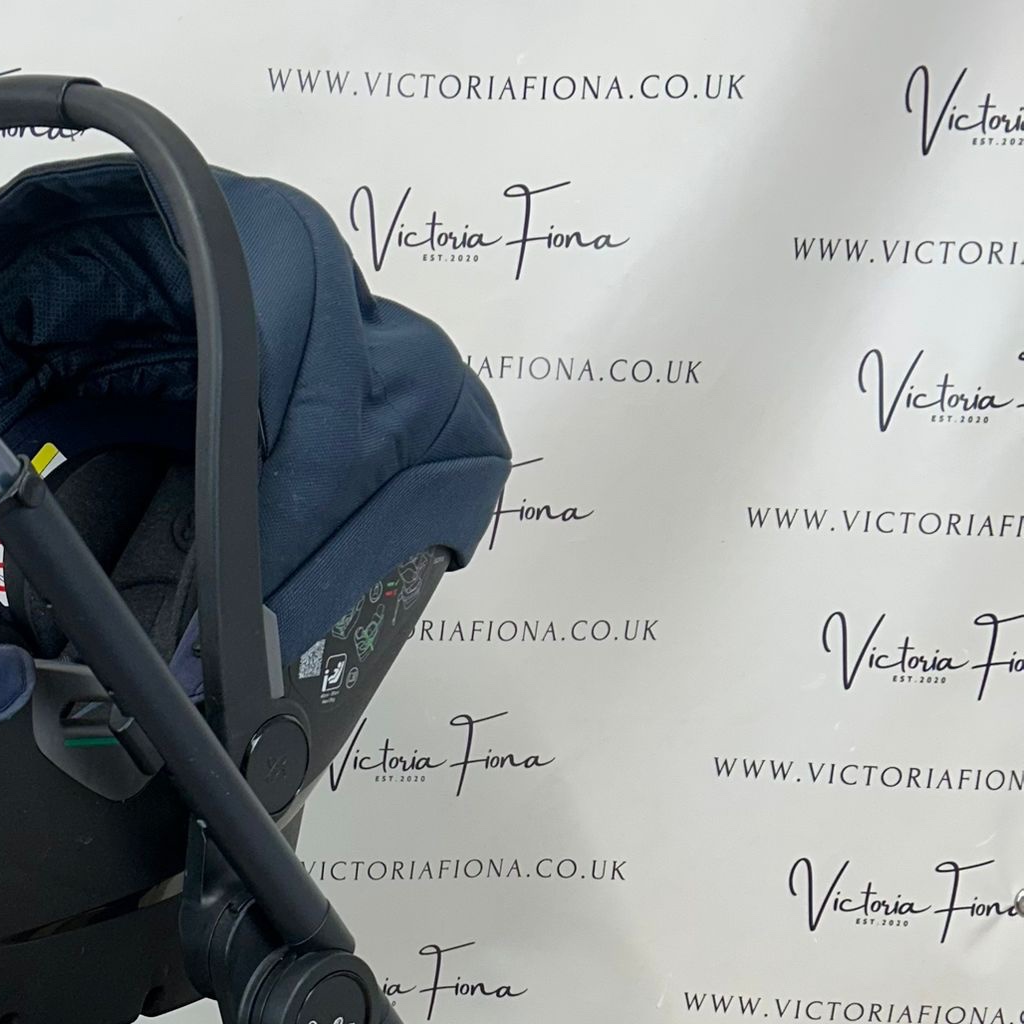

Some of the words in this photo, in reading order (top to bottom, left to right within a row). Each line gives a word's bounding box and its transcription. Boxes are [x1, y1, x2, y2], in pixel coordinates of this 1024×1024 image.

[267, 67, 746, 101] WWW.VICTORIAFIONA.CO.UK
[904, 64, 1024, 157] Victori
[349, 185, 503, 273] Victoria
[502, 180, 631, 281] Fiona
[793, 236, 1024, 265] WWW.VICTORI
[422, 253, 479, 263] EST.2020
[857, 348, 1015, 433] Victoria
[931, 414, 989, 424] EST.2020
[821, 611, 970, 691] Victoria
[892, 674, 947, 684] EST.2020
[374, 775, 426, 783] EST.2020
[448, 711, 556, 798] Fiona
[788, 857, 932, 932] Victoria
[855, 917, 909, 928] EST.2020
[418, 941, 529, 1021] Fiona
